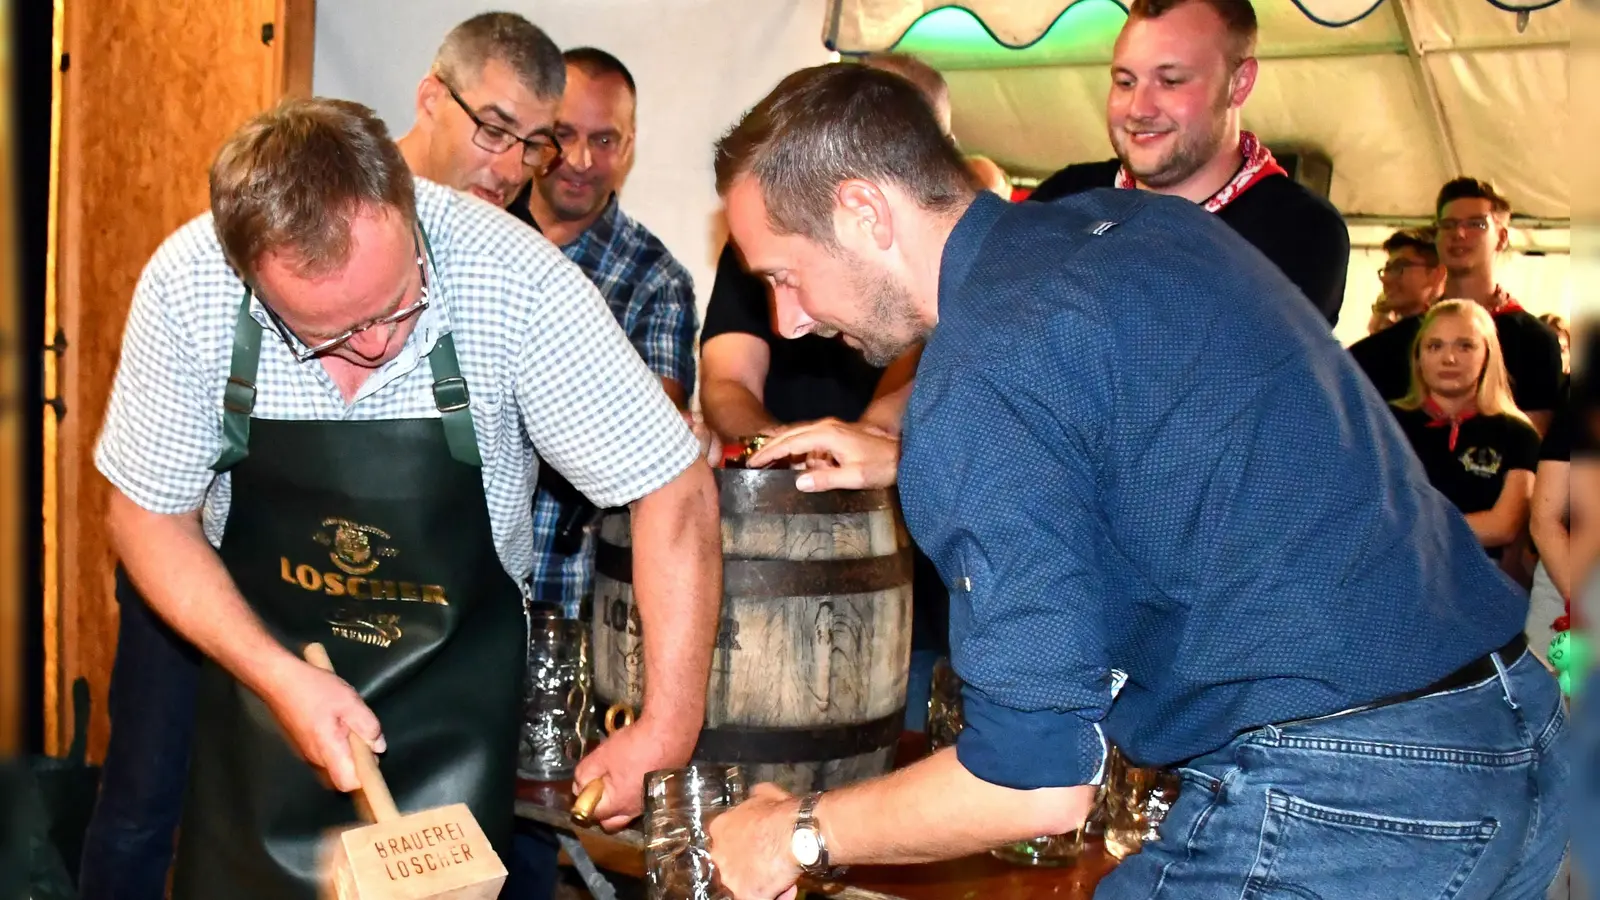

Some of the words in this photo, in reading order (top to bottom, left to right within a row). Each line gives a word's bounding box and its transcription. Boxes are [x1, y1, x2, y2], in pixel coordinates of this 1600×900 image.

[280, 556, 449, 606] LOSCHER
[374, 822, 466, 859] BRAUEREI
[384, 843, 475, 881] LOSCHER
